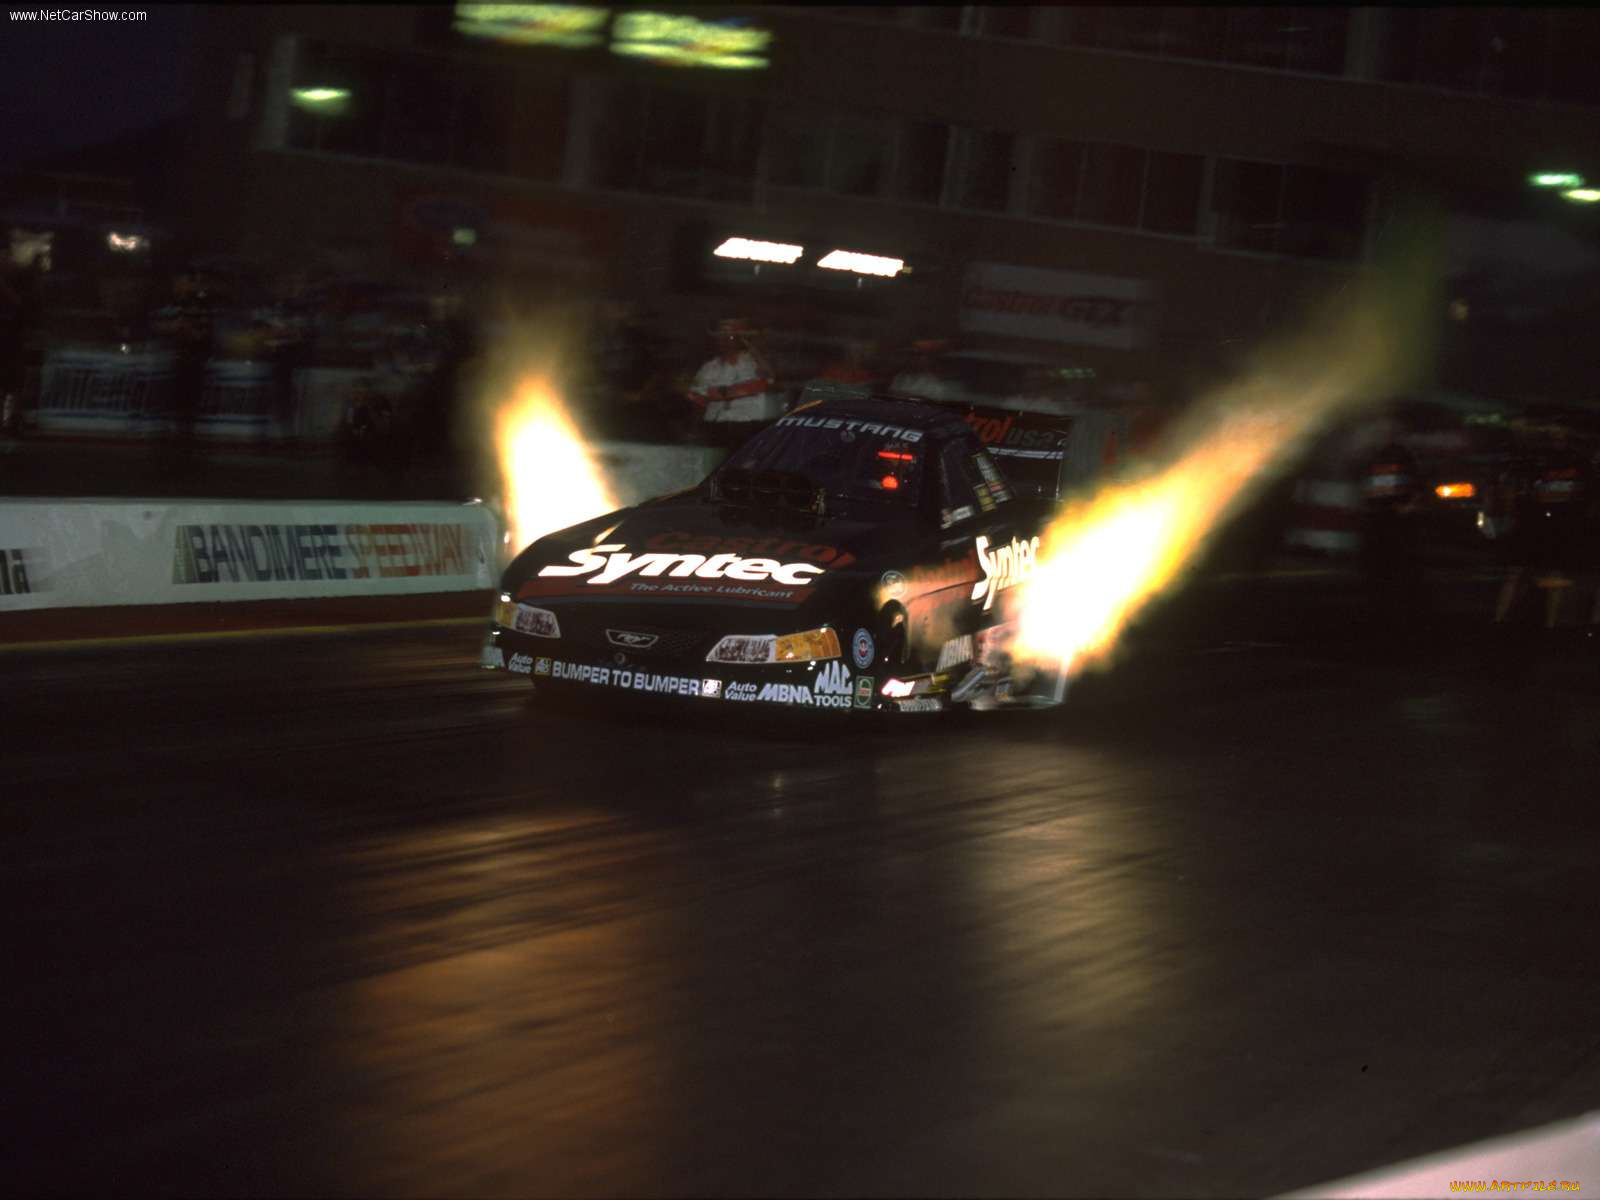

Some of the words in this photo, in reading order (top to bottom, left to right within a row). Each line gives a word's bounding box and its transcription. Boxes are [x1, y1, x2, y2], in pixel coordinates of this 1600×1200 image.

[776, 415, 923, 442] MUSTANG
[190, 525, 347, 583] BANDIMERE
[345, 523, 470, 579] SPEEDWAY
[537, 543, 826, 585] Syntec
[629, 582, 659, 592] The
[660, 582, 713, 593] Active
[716, 585, 795, 599] Lubricant
[552, 660, 611, 686] BUMPER
[611, 669, 633, 689] TO
[633, 672, 701, 697] BUMPER
[727, 681, 758, 693] Auto
[814, 660, 853, 694] MAC
[724, 690, 756, 703] Value
[756, 683, 814, 704] MBNA
[813, 694, 853, 708] TOOLS
